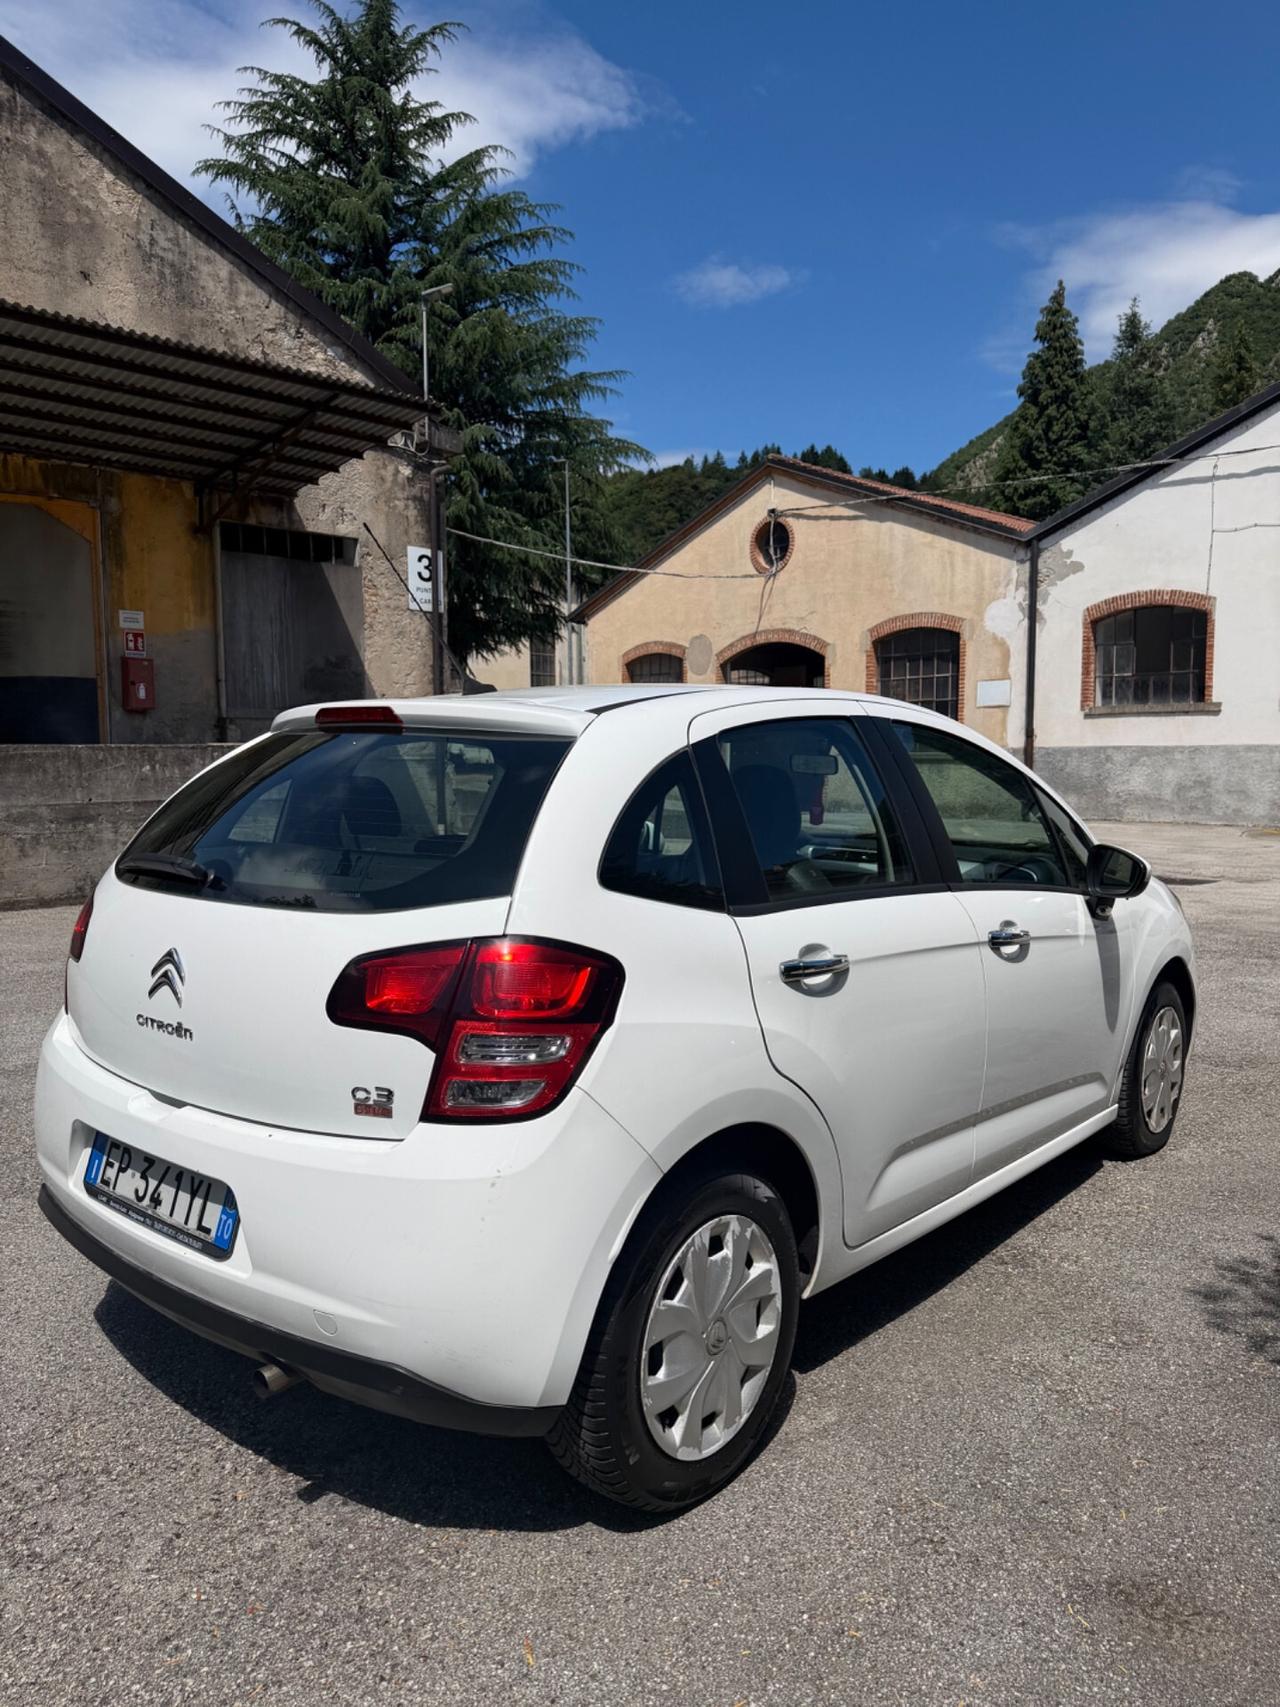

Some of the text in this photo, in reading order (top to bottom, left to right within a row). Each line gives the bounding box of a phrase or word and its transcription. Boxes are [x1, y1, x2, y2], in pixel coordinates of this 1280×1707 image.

[417, 554, 432, 582] 3
[416, 586, 432, 594] PUNT
[351, 1086, 394, 1106] C3
[217, 1214, 233, 1239] TO
